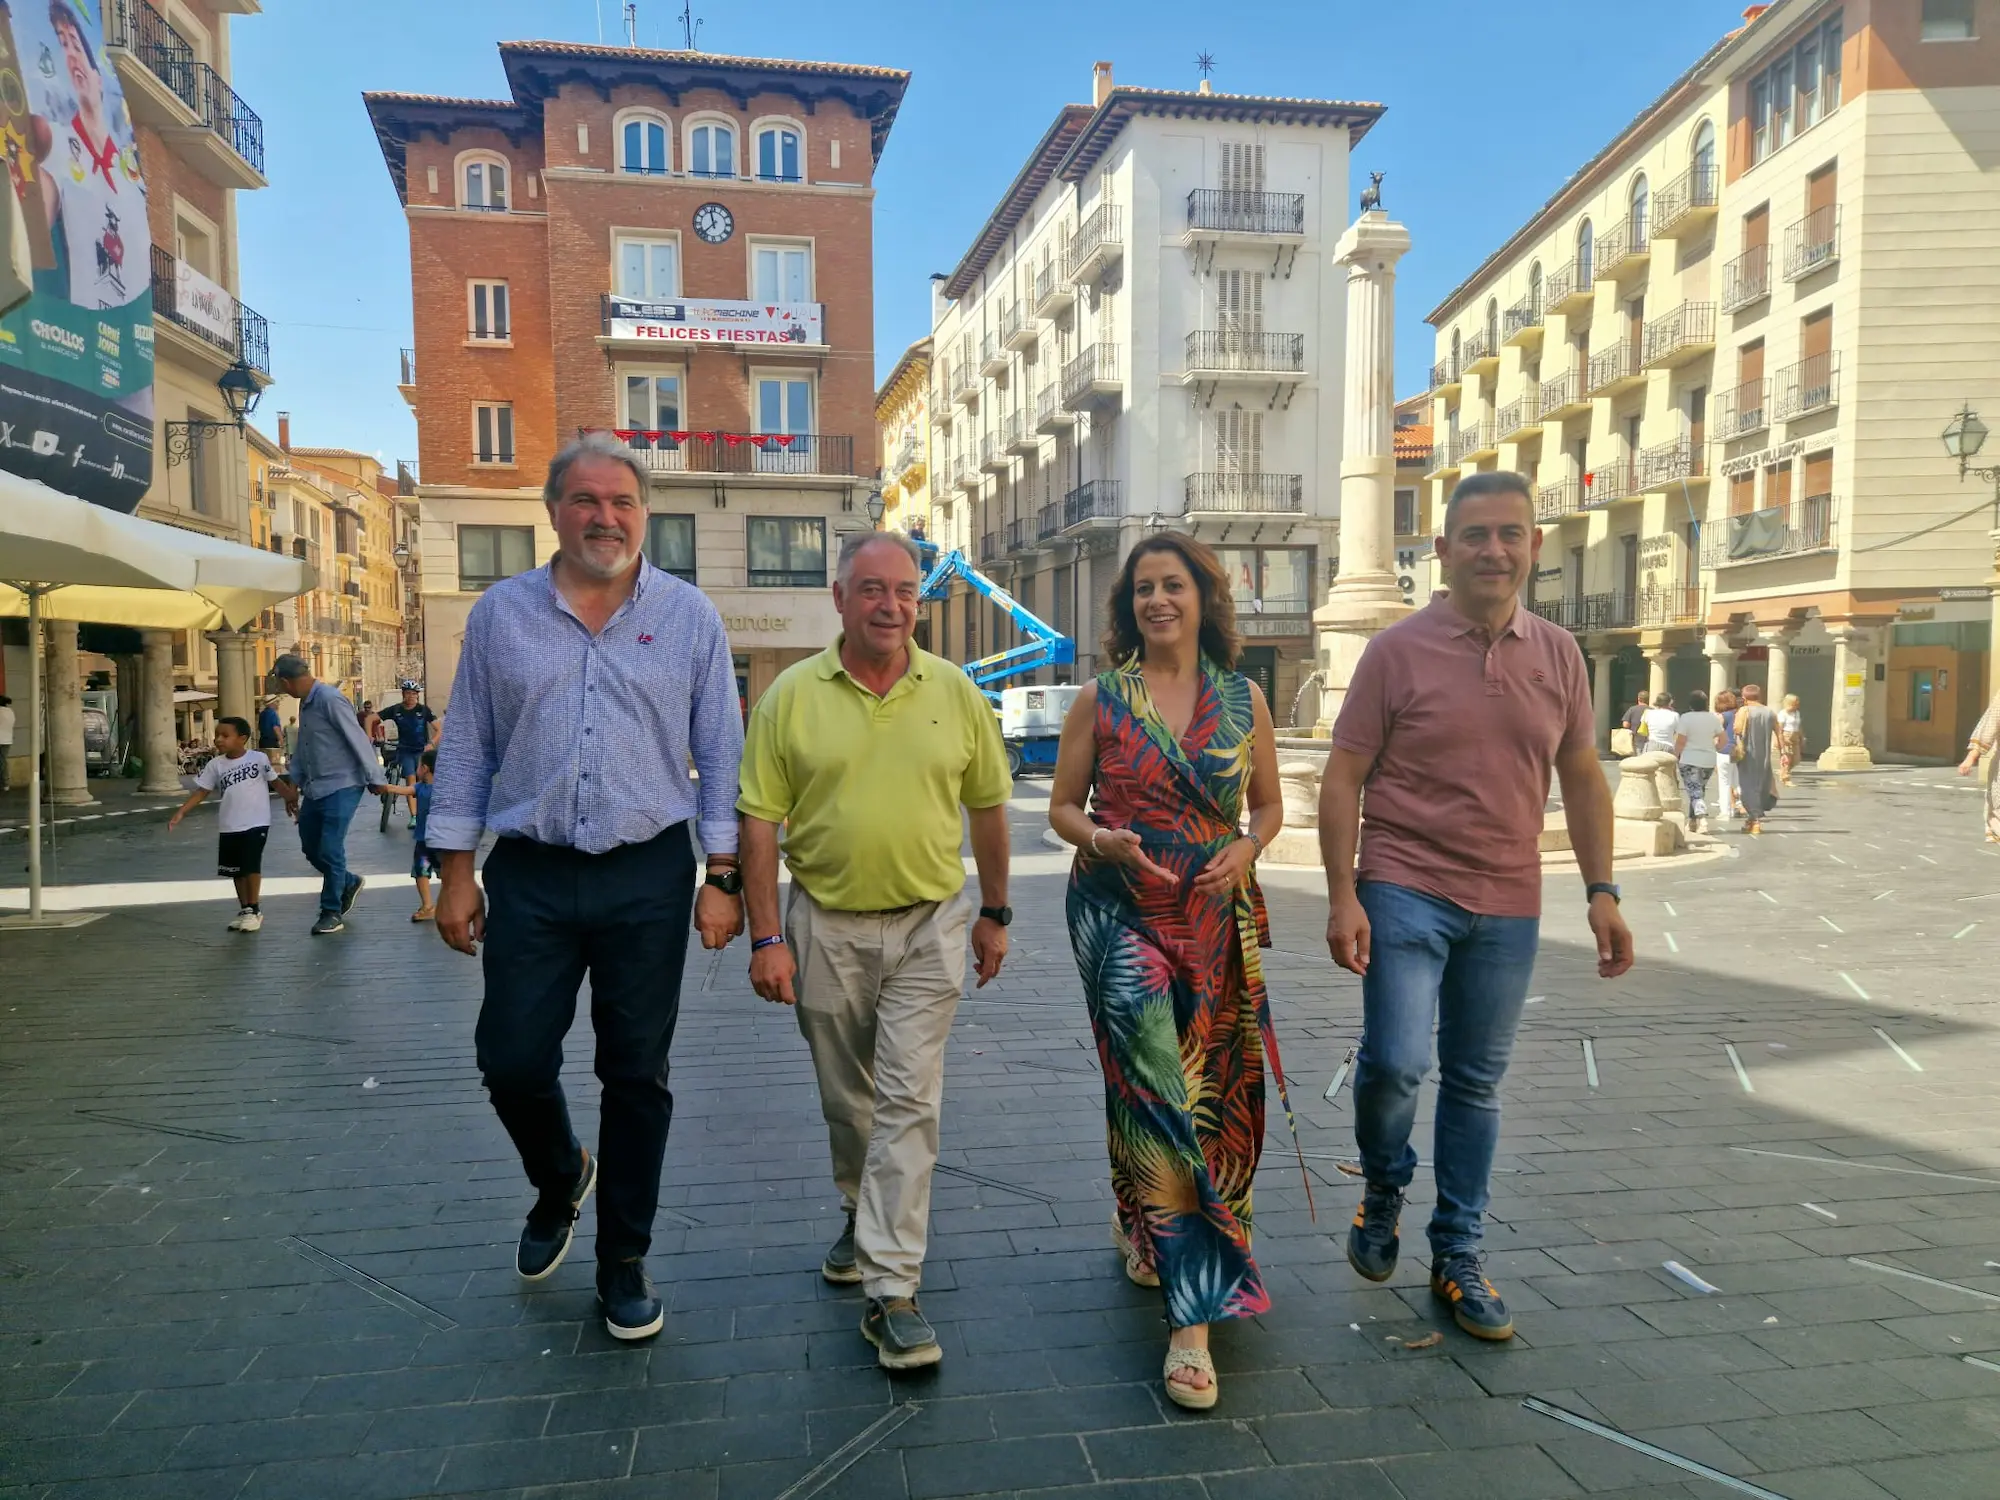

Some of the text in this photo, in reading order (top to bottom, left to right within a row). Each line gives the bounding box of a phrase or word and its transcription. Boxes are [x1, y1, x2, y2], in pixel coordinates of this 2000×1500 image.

[636, 326, 791, 343] FELICES FIESTAS
[1256, 622, 1305, 634] TEJIDOS
